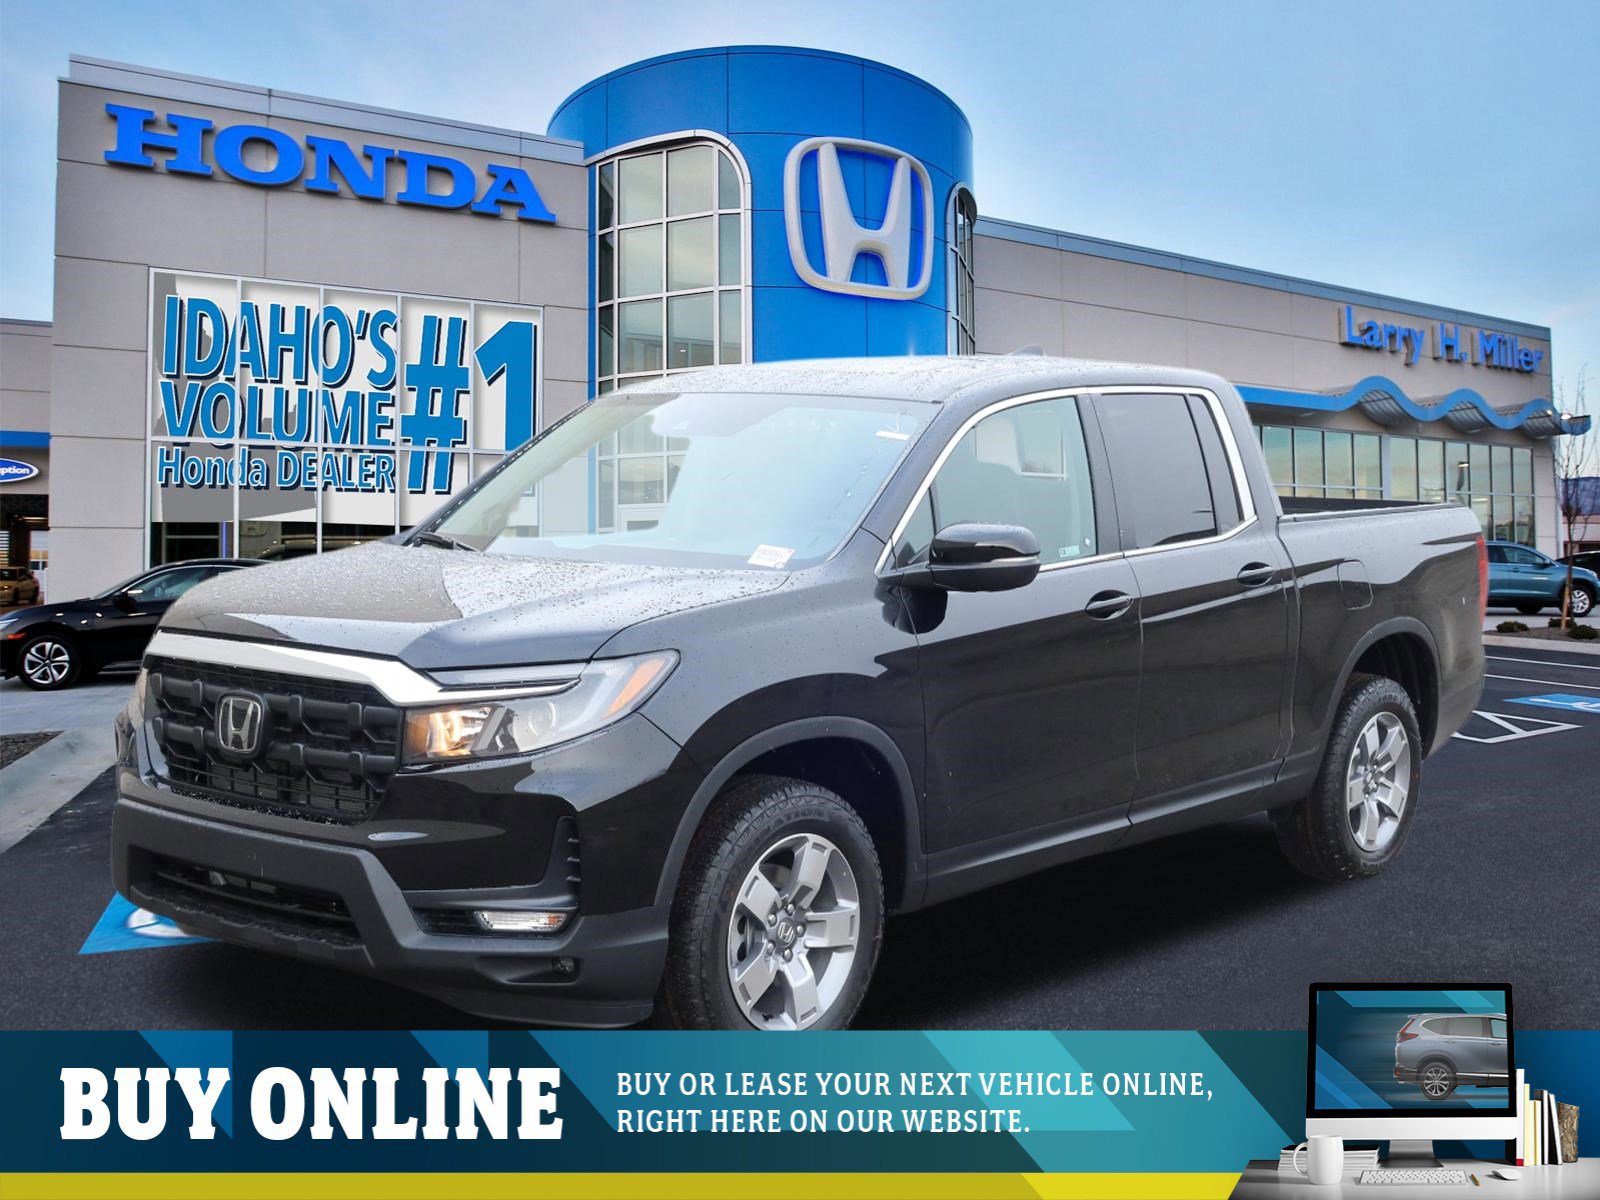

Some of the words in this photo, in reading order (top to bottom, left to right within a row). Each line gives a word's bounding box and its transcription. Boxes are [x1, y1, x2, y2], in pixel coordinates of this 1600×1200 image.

[103, 102, 557, 223] HONDA
[162, 294, 399, 390] IDAHO'S
[1341, 304, 1425, 366] Larry
[1434, 321, 1468, 362] H.
[1473, 329, 1544, 374] Miller
[158, 378, 397, 453] VOLUME
[400, 314, 538, 495] #1
[156, 446, 270, 491] Honda
[275, 449, 397, 494] DEALER
